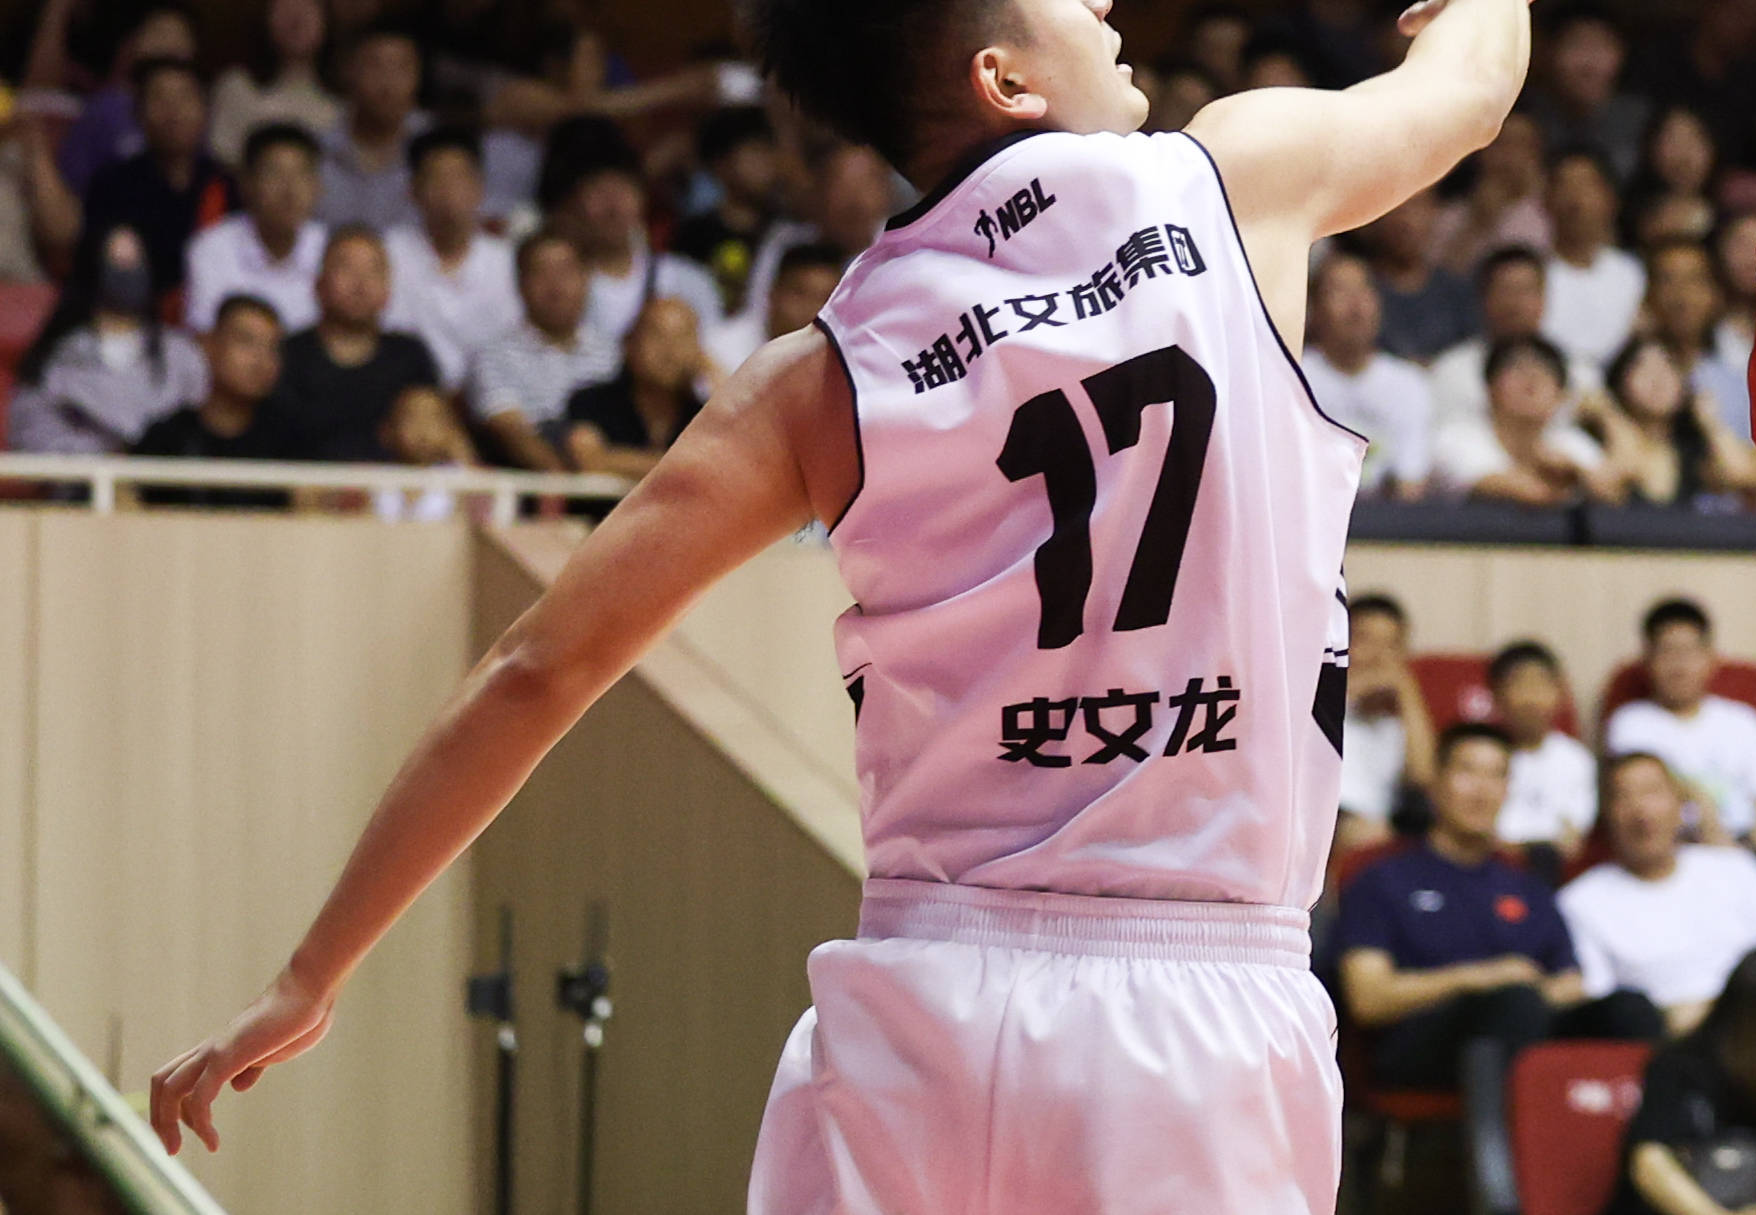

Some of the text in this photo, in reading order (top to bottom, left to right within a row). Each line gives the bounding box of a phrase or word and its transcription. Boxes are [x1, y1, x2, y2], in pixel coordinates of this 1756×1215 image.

[996, 177, 1057, 242] NBL
[901, 223, 1208, 395] 湖北文旅集团
[995, 344, 1218, 650] 17
[997, 674, 1241, 768] 史文龙
